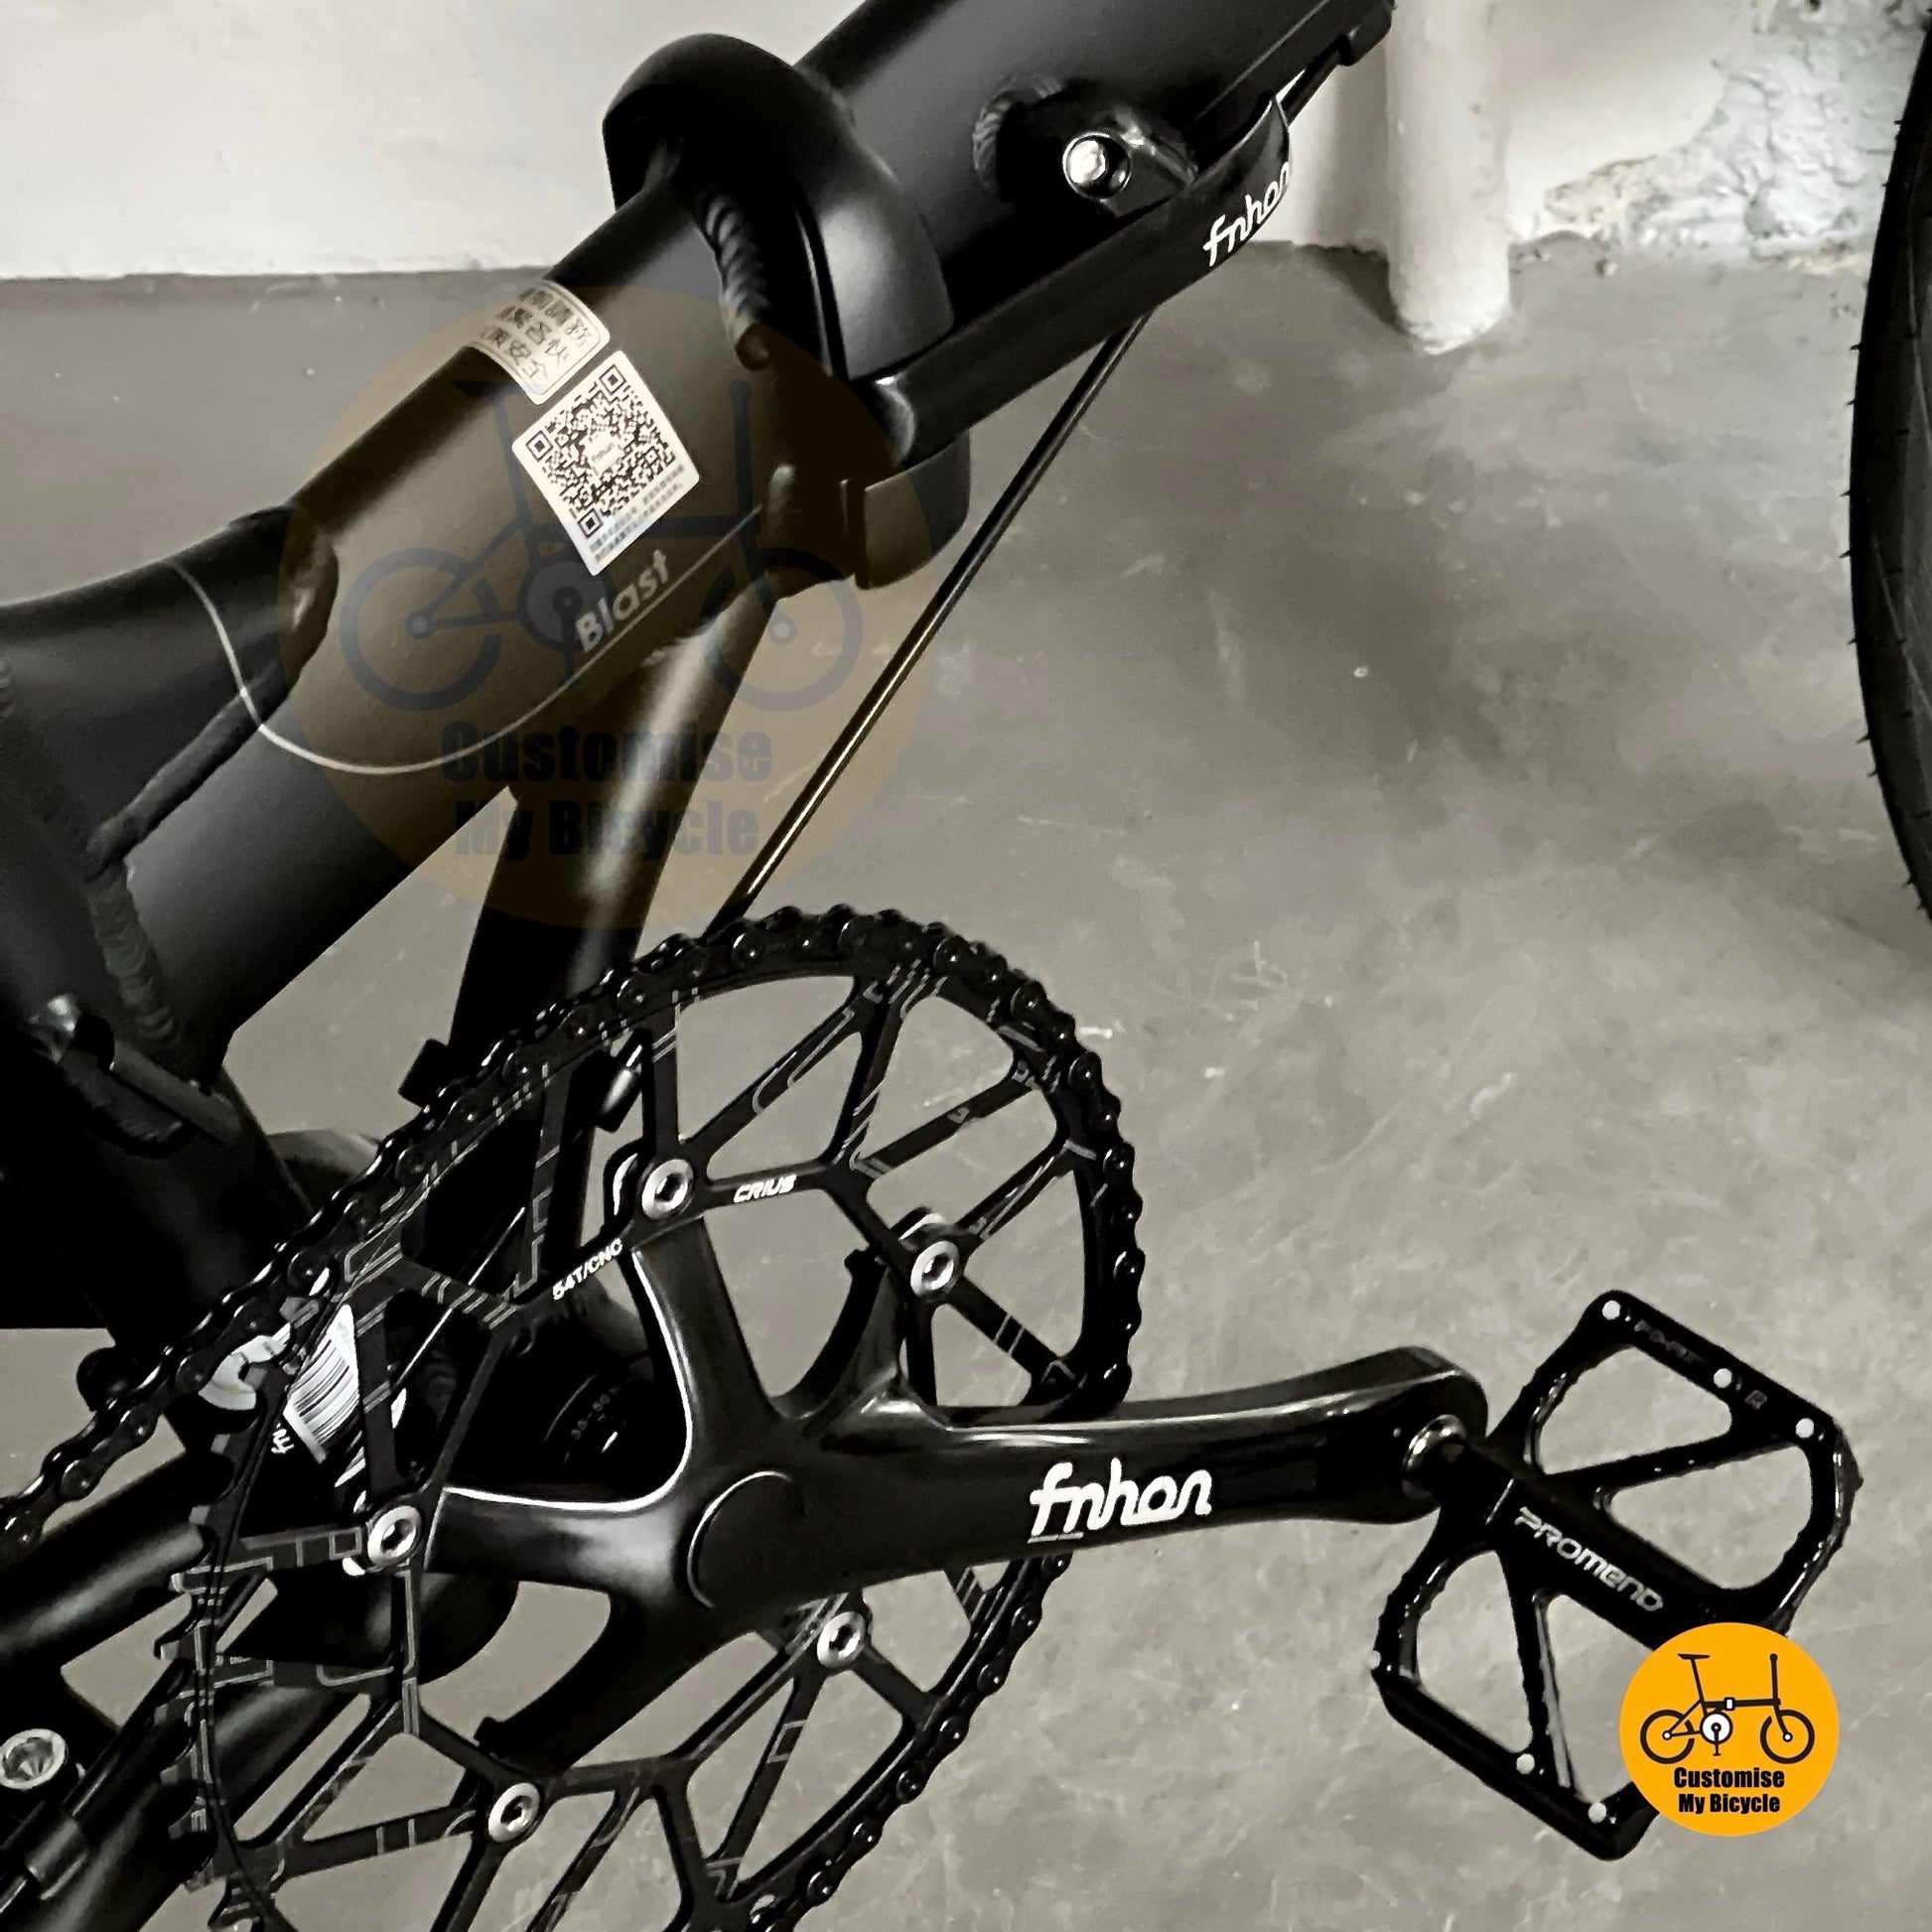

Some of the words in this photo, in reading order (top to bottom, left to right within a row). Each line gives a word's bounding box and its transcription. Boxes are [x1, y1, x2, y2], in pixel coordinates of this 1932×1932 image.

[1202, 162, 1290, 267] fnhon
[576, 550, 669, 653] Blast
[733, 1174, 797, 1203] CRIUS
[552, 1237, 623, 1302] 54T/CNC
[1029, 1456, 1213, 1537] fnhon
